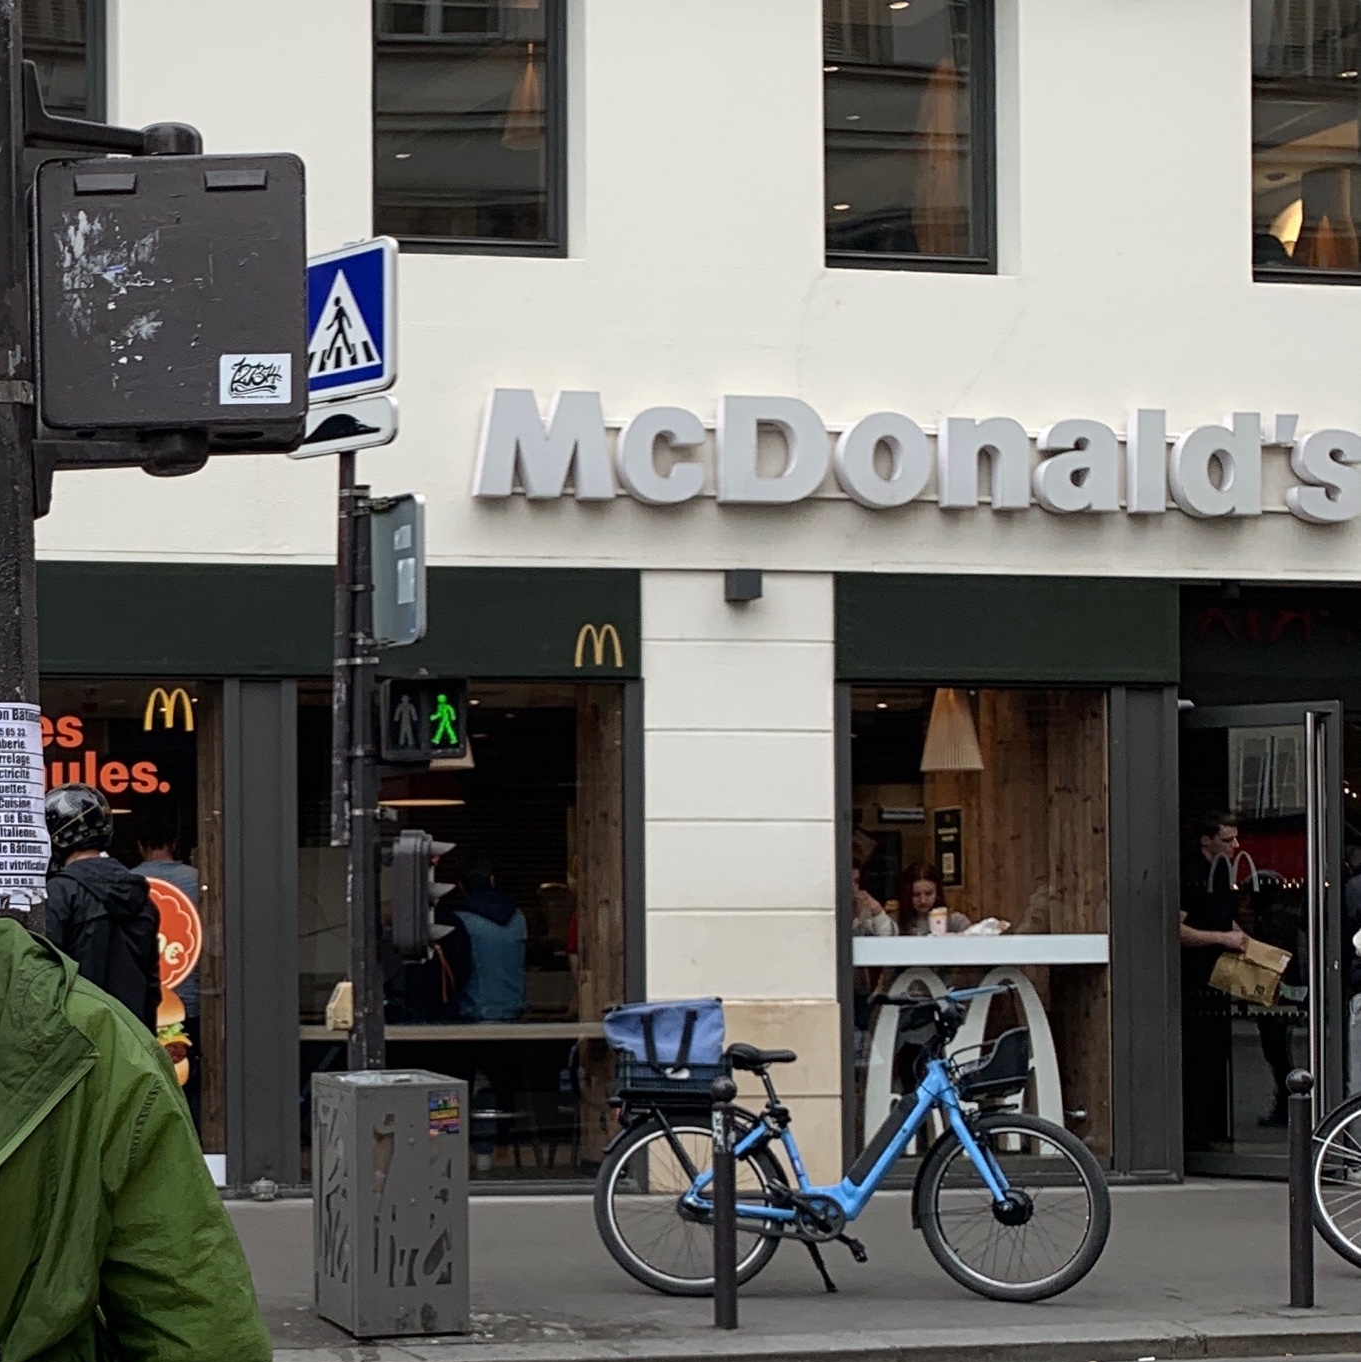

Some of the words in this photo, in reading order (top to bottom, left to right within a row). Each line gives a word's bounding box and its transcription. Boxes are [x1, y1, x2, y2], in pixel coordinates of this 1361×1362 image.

[472, 387, 1361, 524] McDonald's
[44, 750, 171, 794] ules.
[0, 843, 8, 853] le
